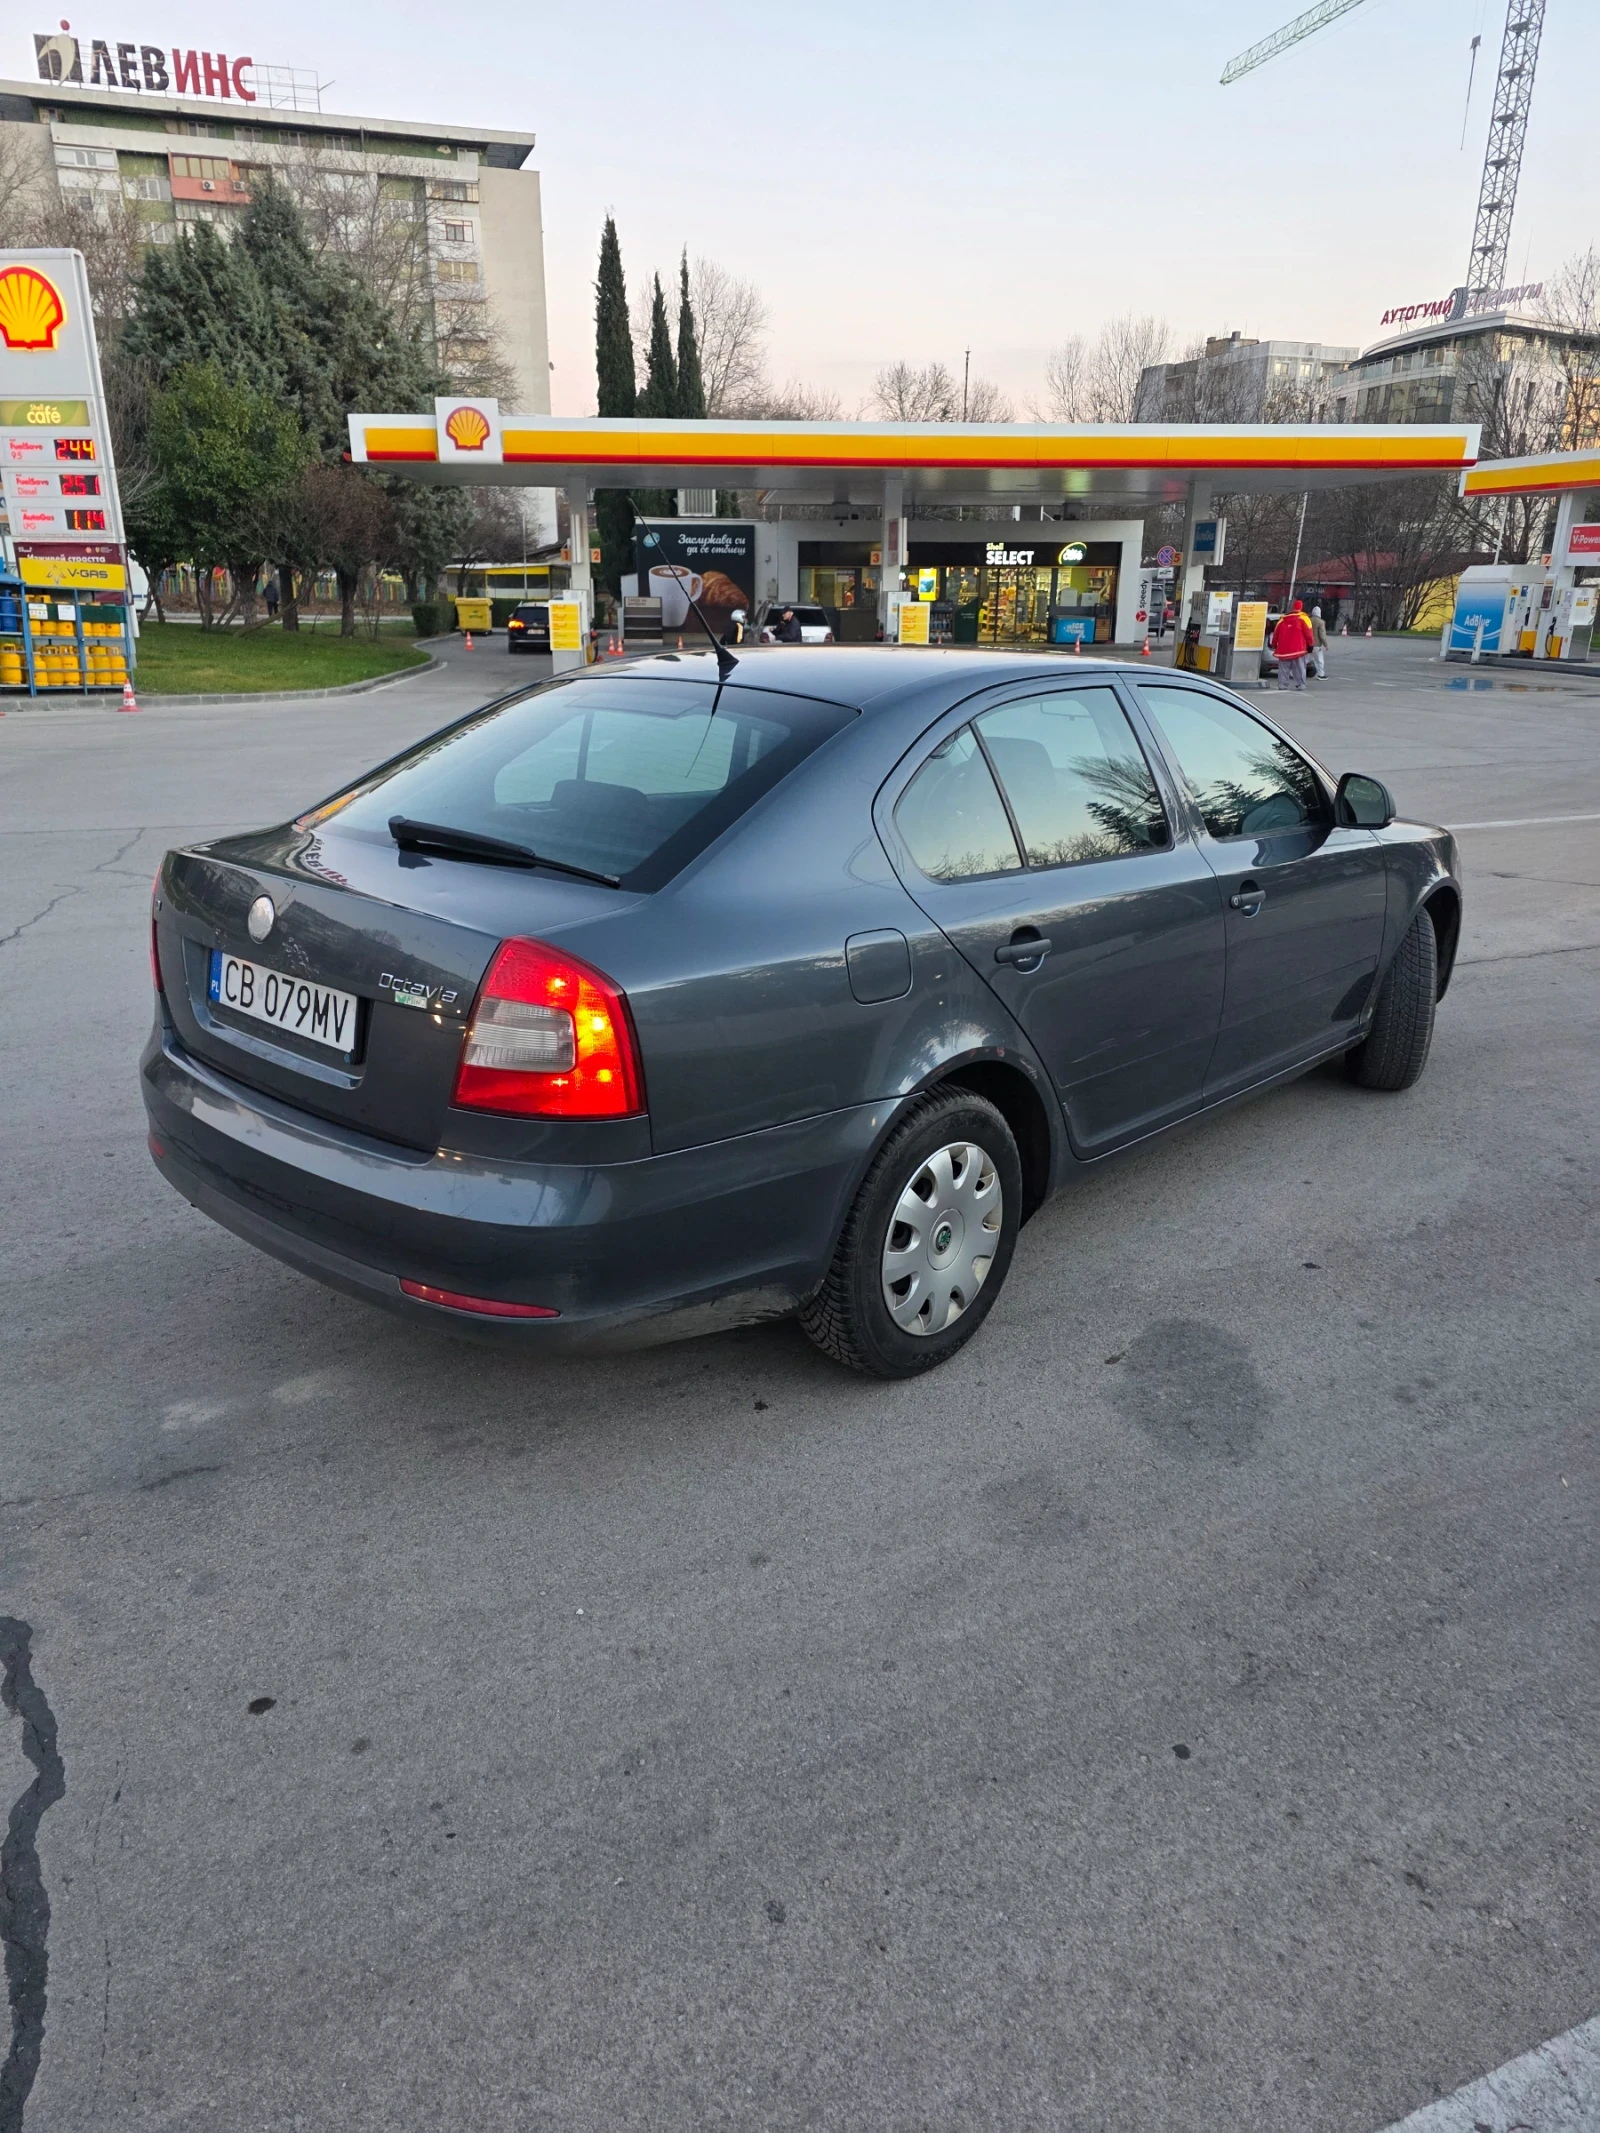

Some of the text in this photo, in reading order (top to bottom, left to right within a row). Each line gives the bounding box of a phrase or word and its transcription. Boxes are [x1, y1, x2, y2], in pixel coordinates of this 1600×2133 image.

[1380, 299, 1454, 325] АУТОГУМИ
[27, 406, 61, 424] café
[11, 451, 23, 460] 95
[16, 478, 49, 486] FuelSave
[18, 487, 37, 495] Diesel
[22, 513, 54, 521] AutoGas
[23, 522, 36, 530] LPG
[678, 533, 746, 547] Заслужава си
[1572, 534, 1600, 545] V-Powe
[686, 546, 698, 556] да
[700, 546, 710, 554] се
[986, 542, 1005, 551] Shell
[592, 550, 600, 561] 2
[871, 552, 880, 563] 3
[985, 550, 1035, 566] SELECT
[1173, 553, 1181, 563] 5
[1544, 555, 1551, 563] 7
[67, 568, 108, 579] V-GAS
[1139, 579, 1150, 608] speedy
[1463, 614, 1491, 627] AdBlue
[210, 980, 220, 994] PL
[378, 972, 459, 1004] Octavia
[225, 960, 349, 1043] CB 079MV
